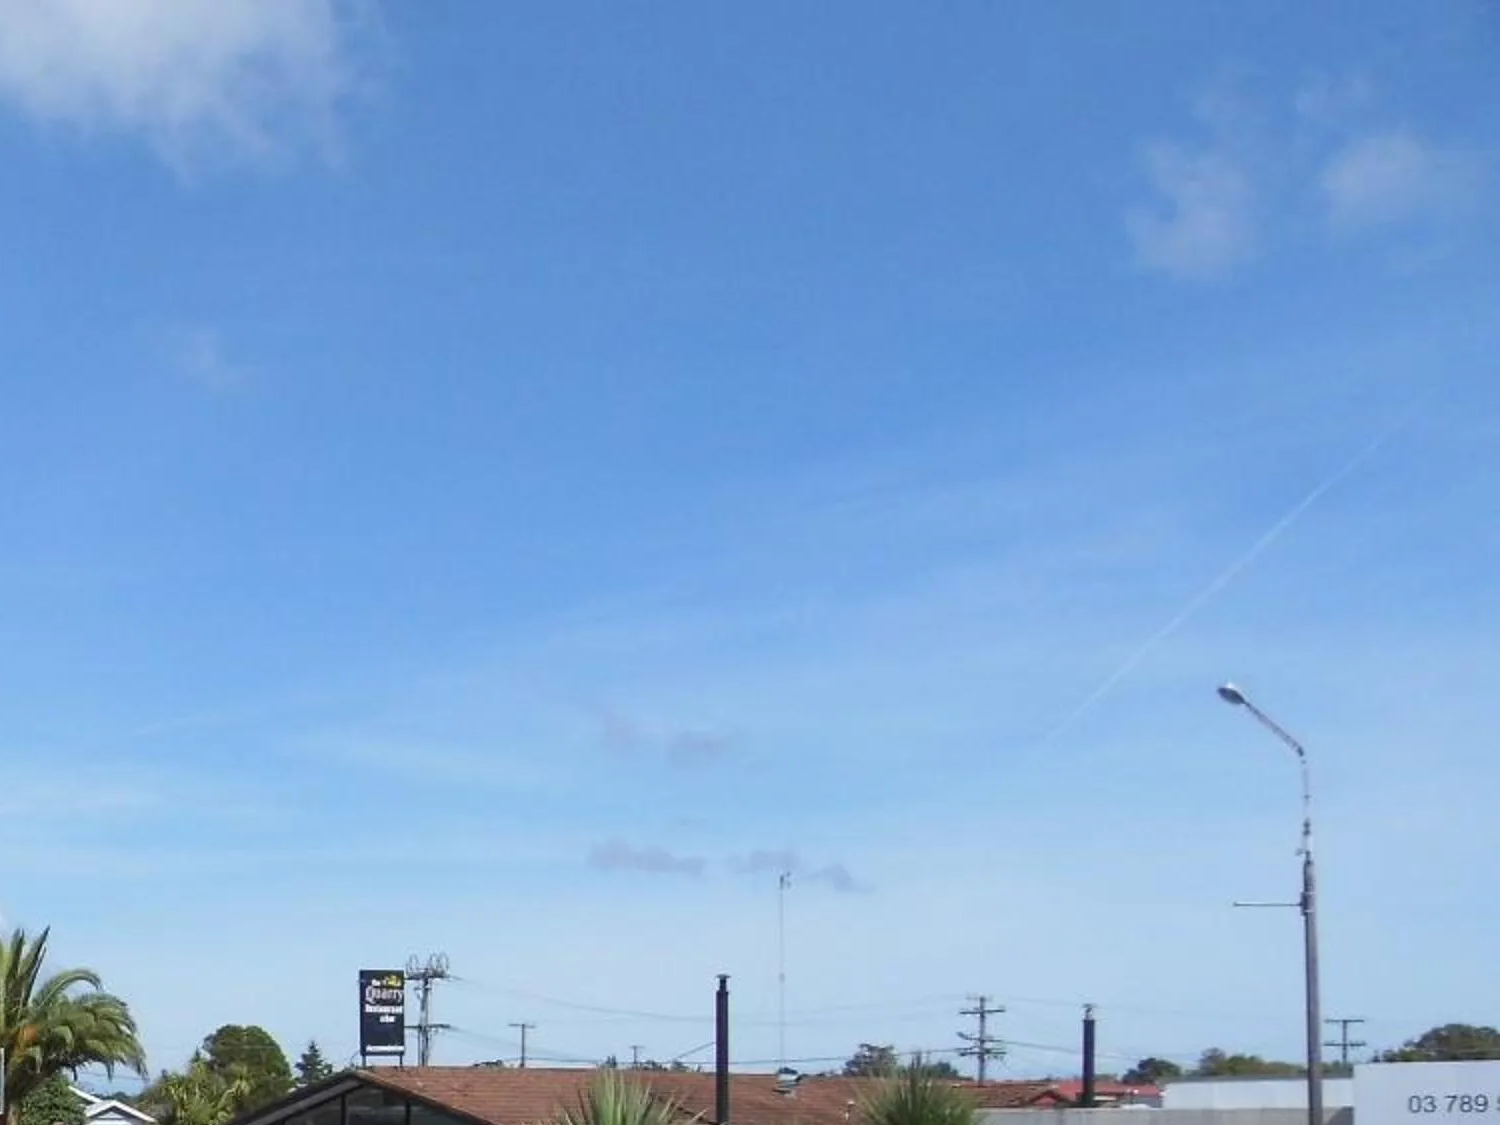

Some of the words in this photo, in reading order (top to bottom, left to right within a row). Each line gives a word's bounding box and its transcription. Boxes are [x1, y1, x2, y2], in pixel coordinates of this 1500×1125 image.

[365, 985, 403, 1004] Quarry
[1408, 1095, 1437, 1113] 03
[1444, 1094, 1489, 1113] 789
